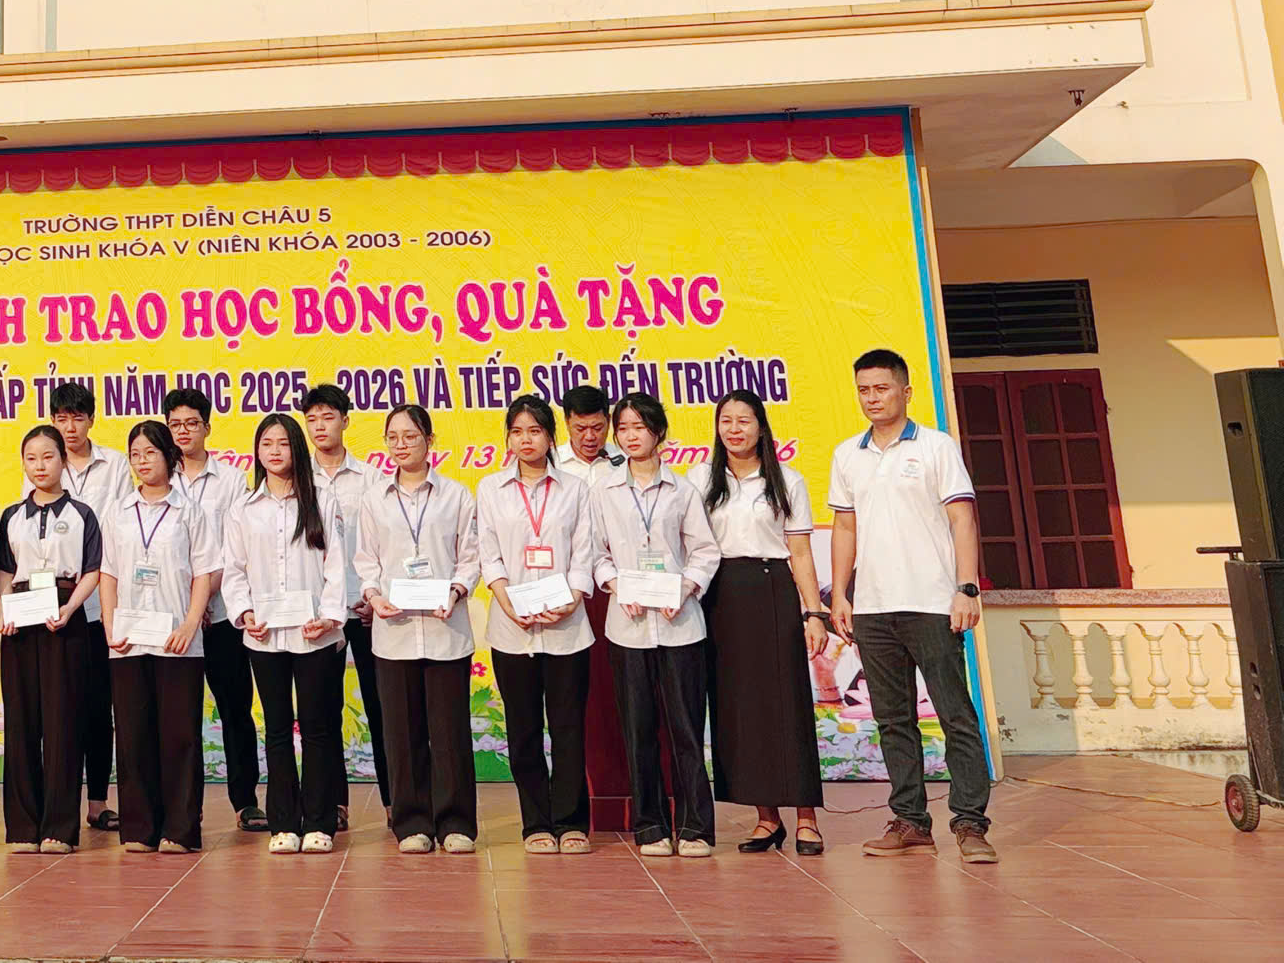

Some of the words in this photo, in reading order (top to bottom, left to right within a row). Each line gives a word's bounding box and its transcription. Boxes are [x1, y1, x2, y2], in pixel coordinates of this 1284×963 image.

[23, 213, 118, 234] TRƯỜNG
[125, 214, 174, 230] THPT
[182, 205, 234, 227] DIỄN
[242, 207, 310, 225] CHÂU
[318, 208, 331, 222] 5
[39, 243, 90, 260] SINH
[99, 238, 166, 258] KHÓA
[174, 240, 189, 254] V
[198, 234, 260, 255] (NIÊN
[269, 231, 338, 251] KHÓA
[346, 233, 401, 249] 2003
[426, 230, 492, 248] 2006)
[39, 292, 168, 342] TRAO
[181, 288, 279, 350] HỌC
[292, 258, 443, 343] BỔNG,
[456, 266, 567, 342] QUÀ
[578, 263, 724, 339] TẶNG
[104, 365, 166, 416] NĂM
[240, 370, 308, 413] 2025
[336, 368, 406, 410] 2026
[413, 358, 452, 409] VÀ
[458, 350, 522, 408] TIẾP
[599, 347, 660, 405] ĐẾN
[666, 349, 789, 404] TRƯỜNG
[461, 445, 496, 468] 13
[658, 440, 710, 464] ăm
